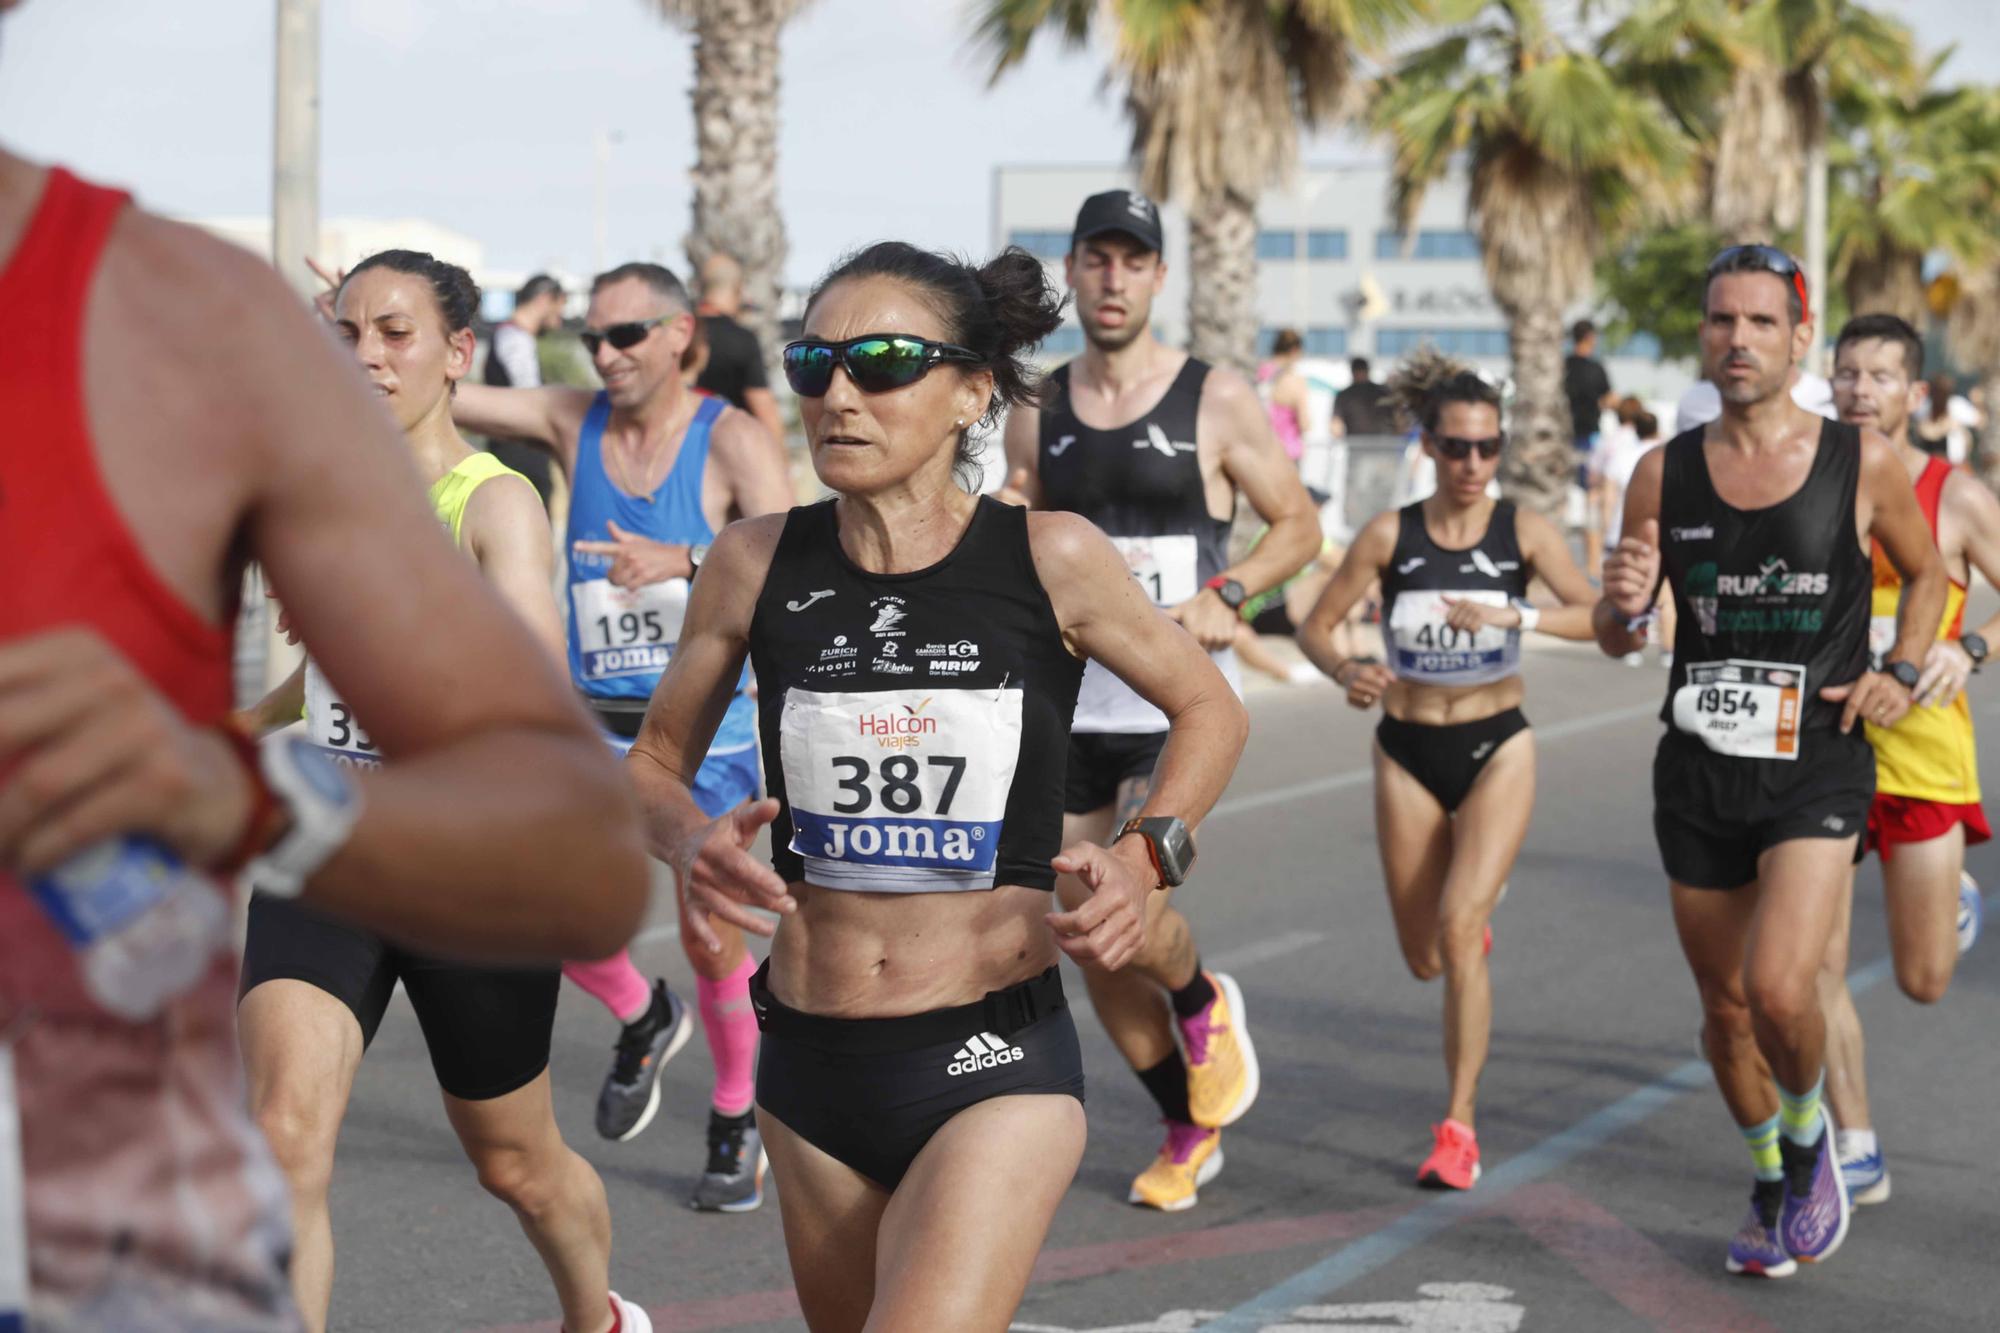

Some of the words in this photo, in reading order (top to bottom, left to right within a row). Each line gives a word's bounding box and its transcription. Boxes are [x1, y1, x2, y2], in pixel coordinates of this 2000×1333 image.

[597, 610, 663, 645] 195
[592, 646, 670, 676] Joma
[817, 660, 856, 673] HOOKI
[820, 647, 858, 657] ZURICH
[929, 660, 981, 672] MRW
[1697, 687, 1758, 717] 1954
[877, 735, 920, 752] viajes
[831, 754, 967, 816] 387
[946, 1046, 1024, 1076] adidas
